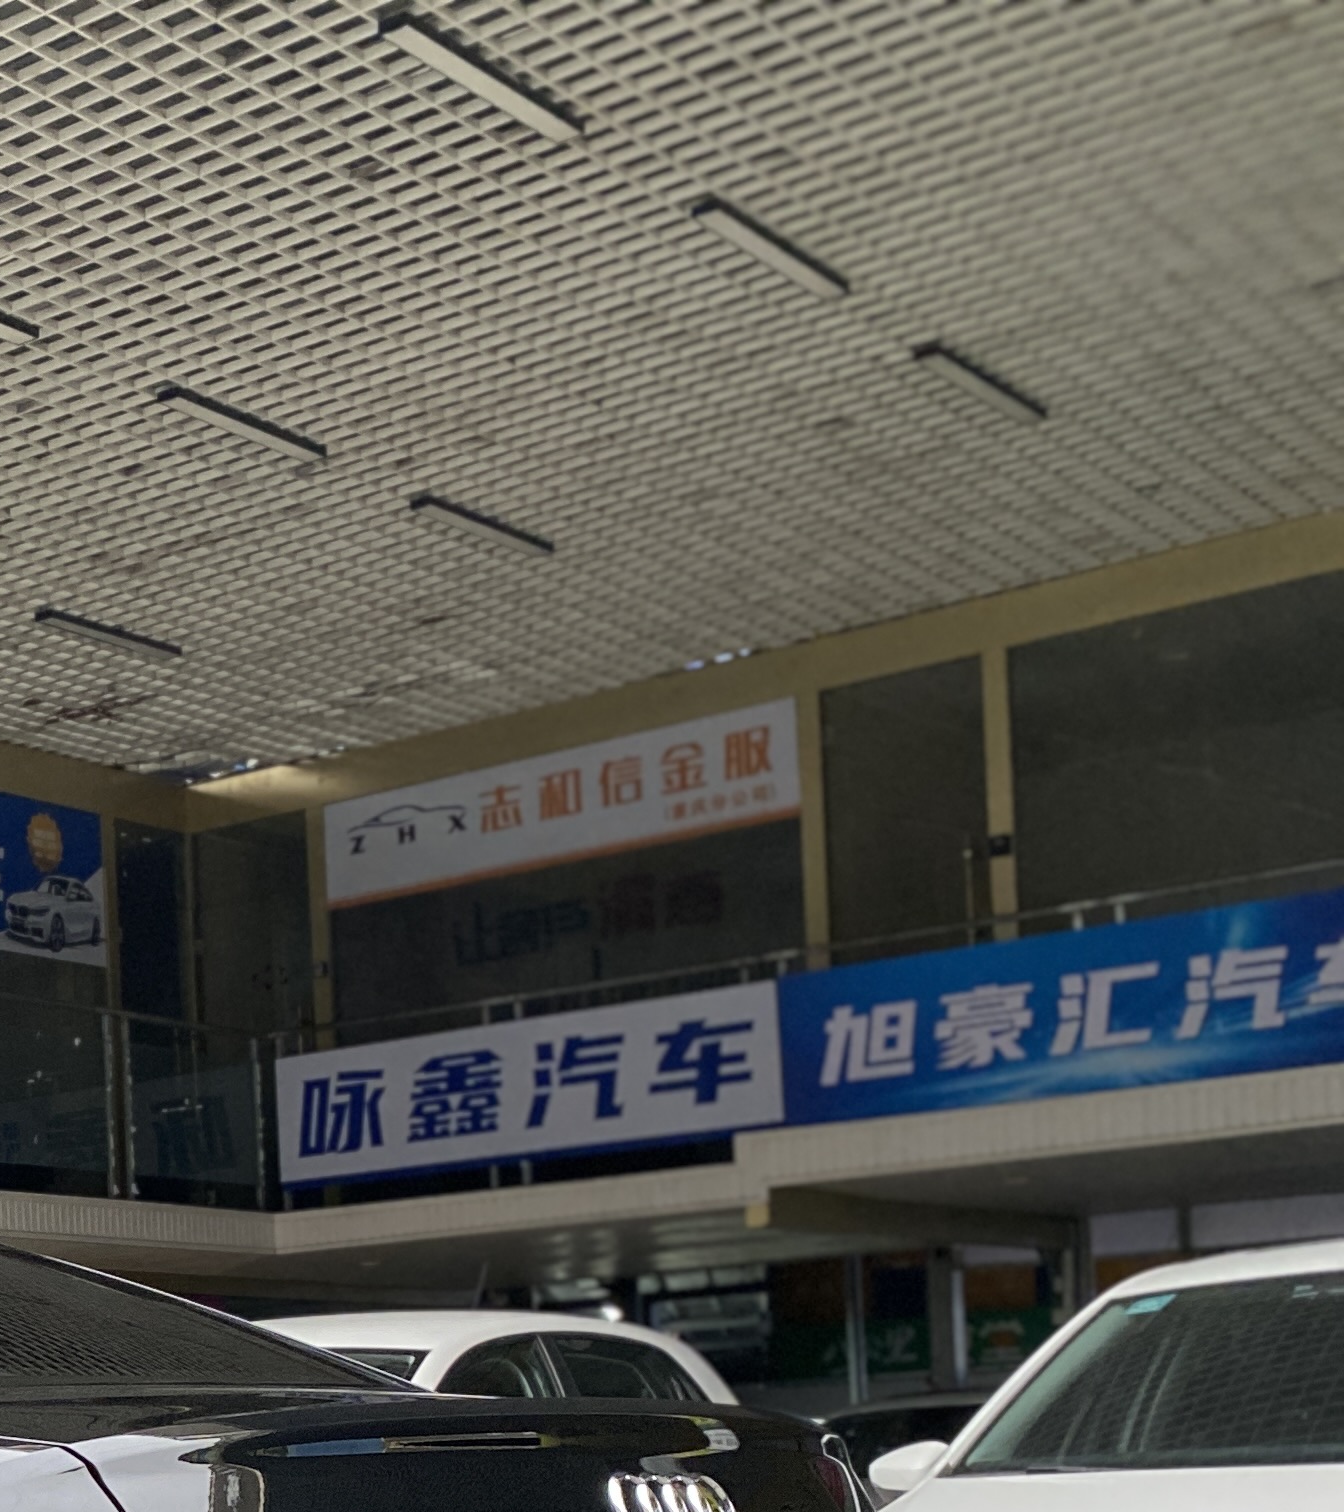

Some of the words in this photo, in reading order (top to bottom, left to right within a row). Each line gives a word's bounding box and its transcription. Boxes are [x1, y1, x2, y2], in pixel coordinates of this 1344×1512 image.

[479, 725, 775, 835] 志和信金服
[297, 1018, 756, 1159] 咏鑫汽车
